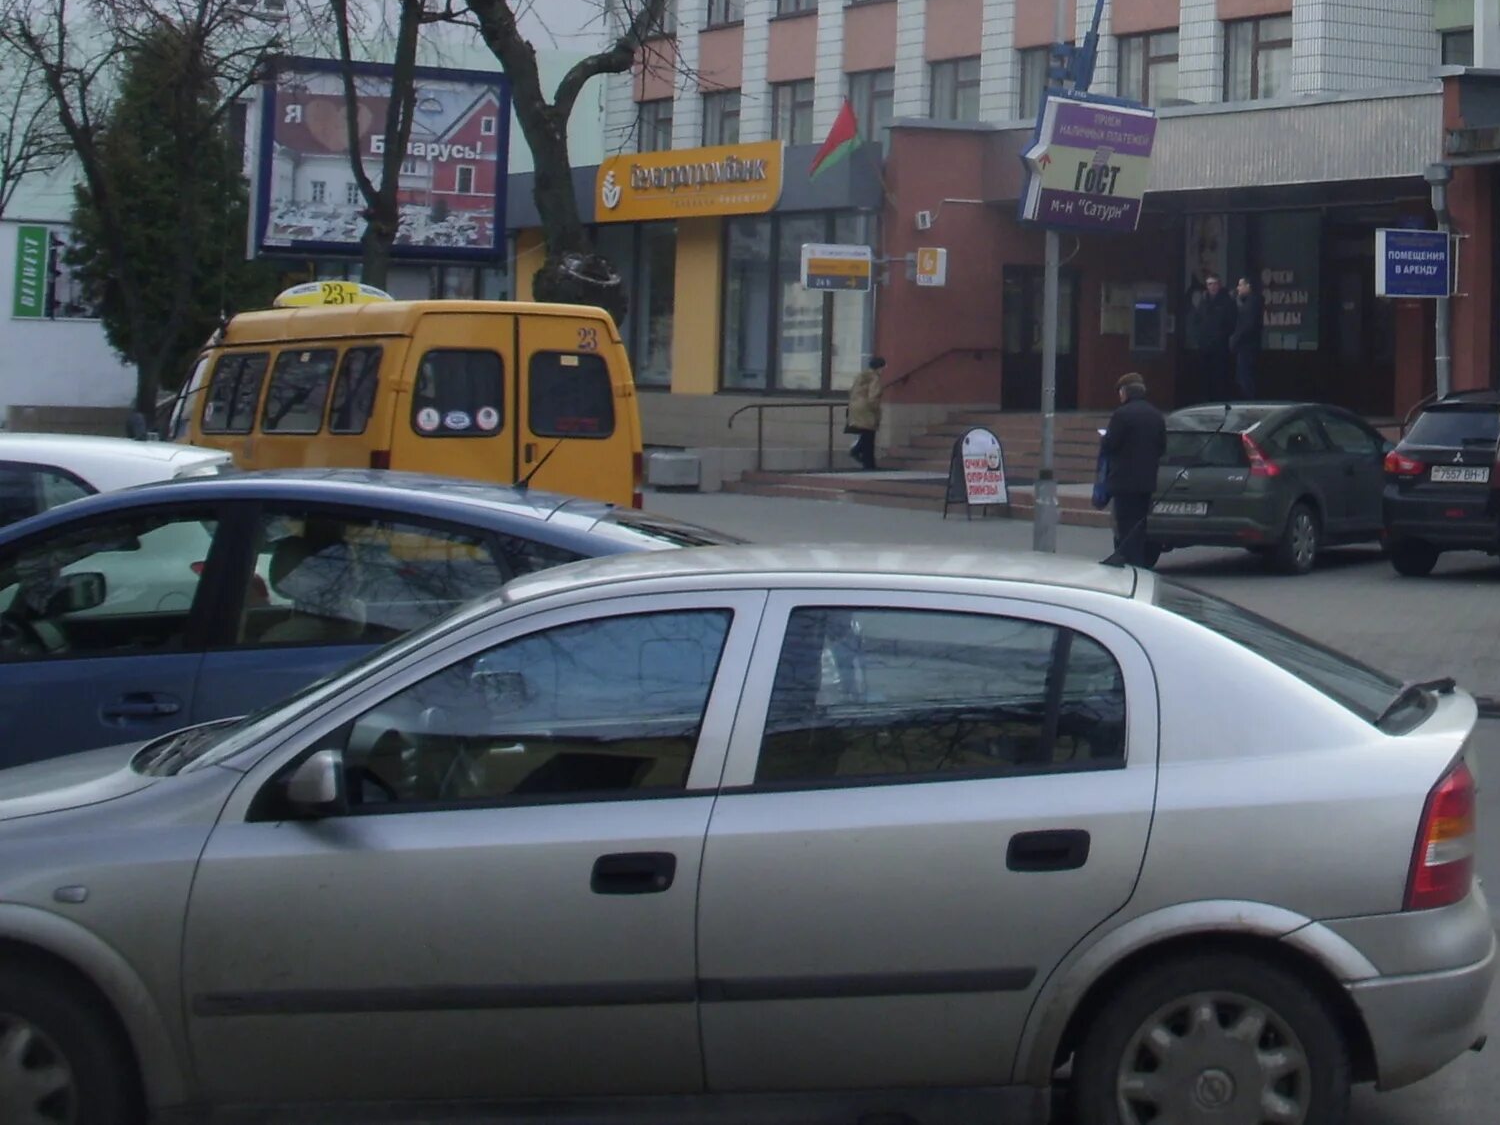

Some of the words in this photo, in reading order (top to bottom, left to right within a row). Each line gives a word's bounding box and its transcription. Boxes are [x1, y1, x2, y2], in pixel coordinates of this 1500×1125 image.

[284, 105, 302, 124] Я
[370, 134, 483, 162] Барусь!
[1388, 250, 1445, 261] ПОМЕЩЕНИЯ
[1403, 265, 1438, 275] АРЕНДУ
[322, 283, 345, 305] 23
[577, 328, 597, 350] 23
